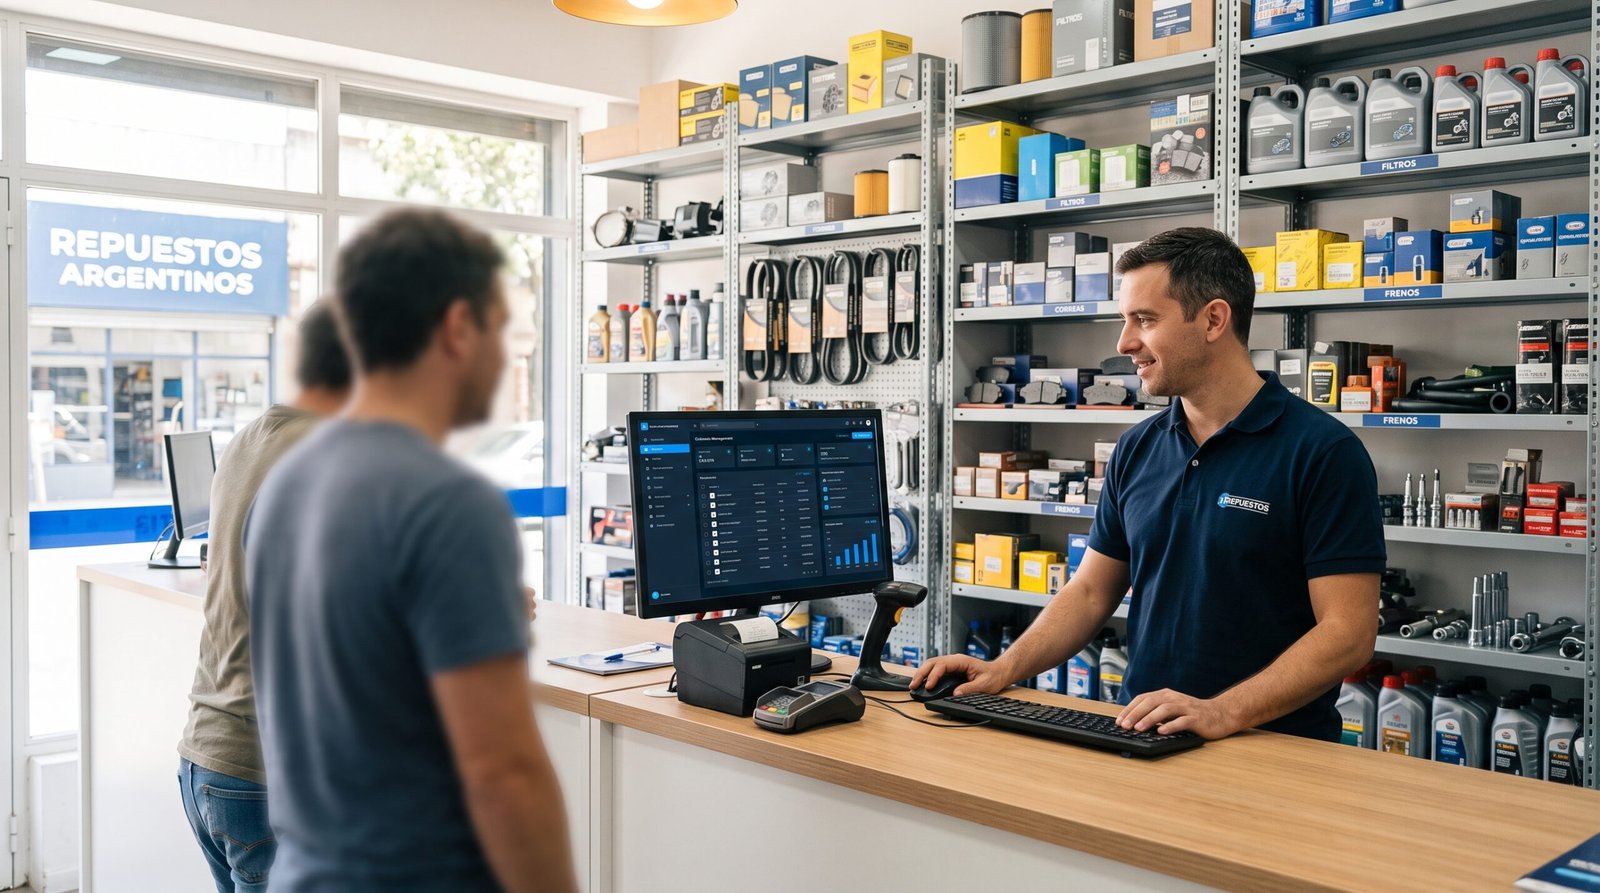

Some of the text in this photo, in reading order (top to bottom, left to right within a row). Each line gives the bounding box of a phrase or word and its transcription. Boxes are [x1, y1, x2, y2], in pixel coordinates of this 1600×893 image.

[1381, 159, 1417, 171] FILTROS
[50, 227, 263, 270] REPUESTOS
[59, 262, 254, 296] ARGENTINOS
[1384, 288, 1420, 298] FRENOS
[1054, 304, 1085, 314] CORREAS
[1383, 416, 1418, 425] FRENOS
[1054, 505, 1081, 515] FRENOS
